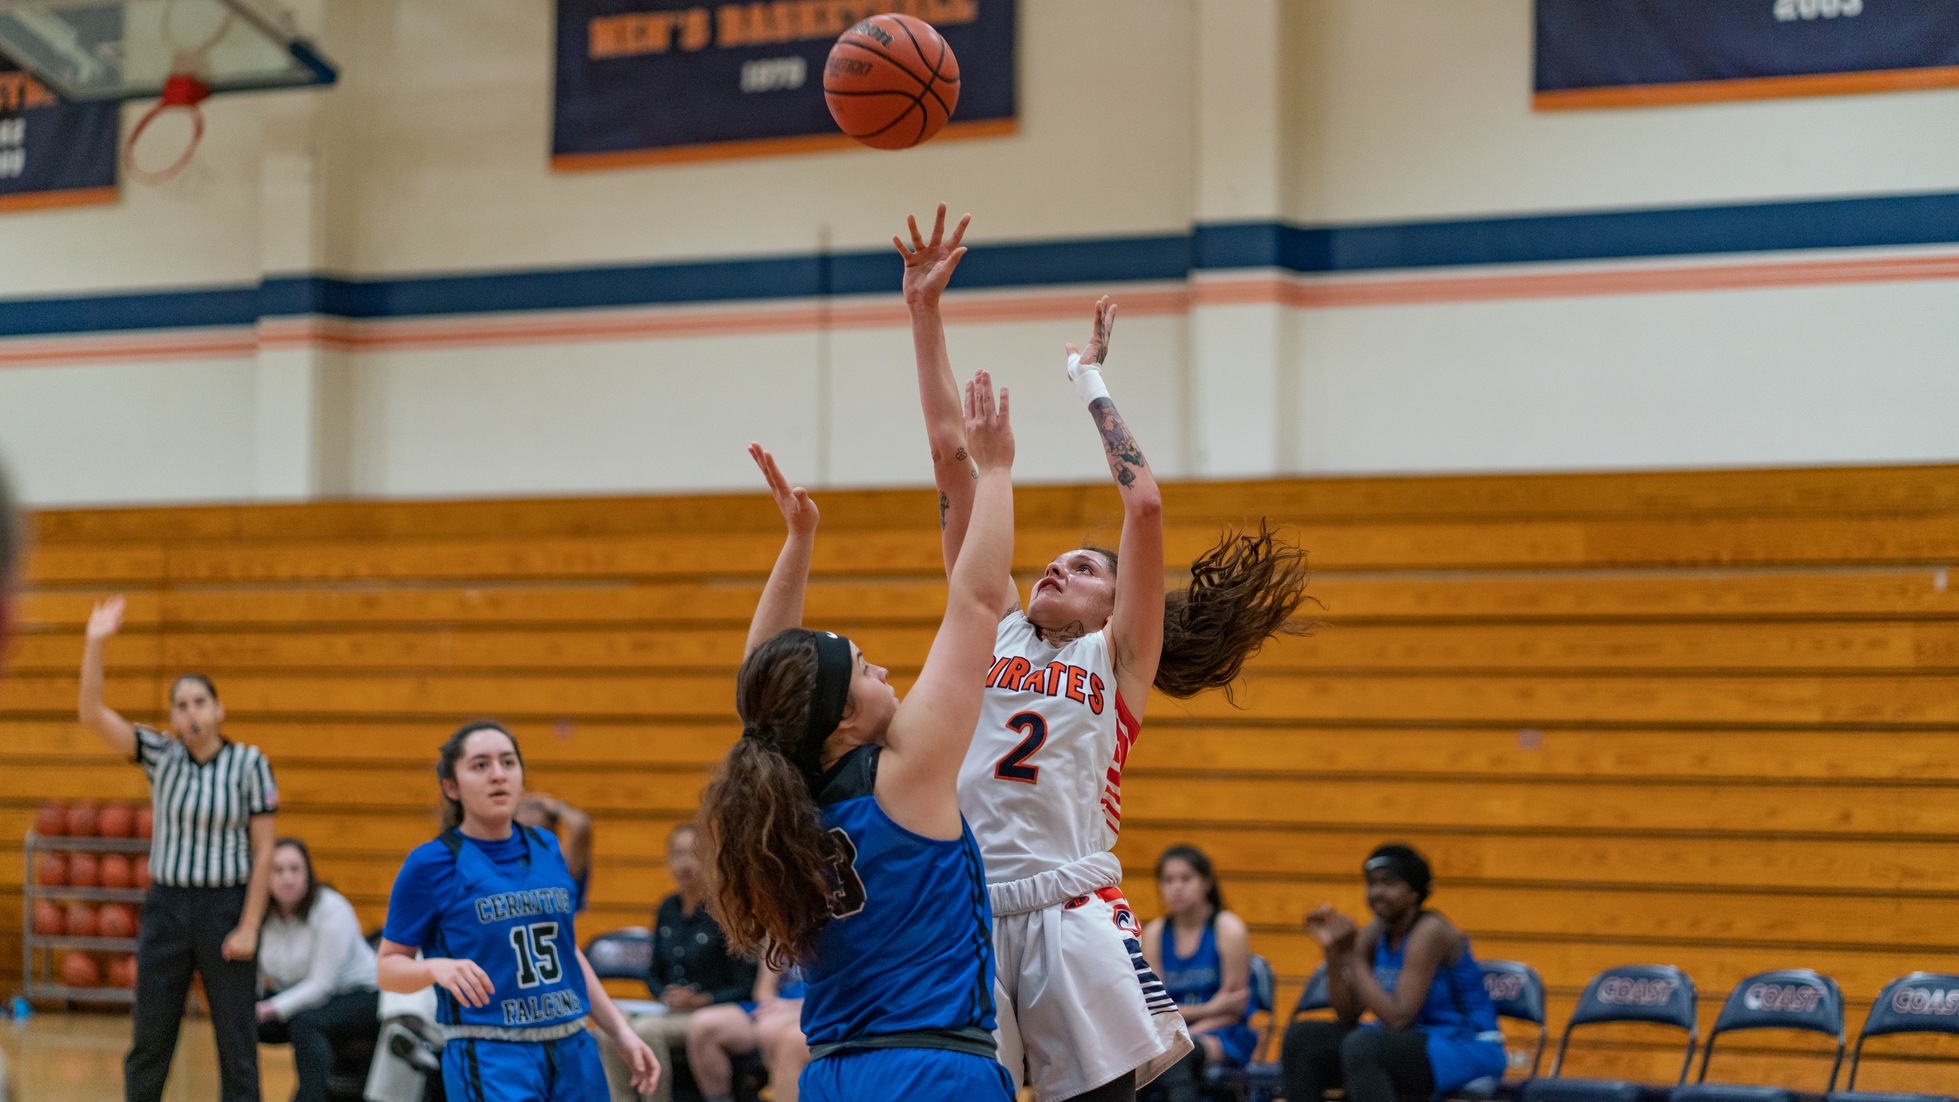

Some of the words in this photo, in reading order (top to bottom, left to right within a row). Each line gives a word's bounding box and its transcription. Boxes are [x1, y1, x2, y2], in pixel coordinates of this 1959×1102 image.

[588, 8, 711, 60] MEN'S
[985, 654, 1106, 716] IRATES
[994, 710, 1049, 785] 2
[509, 921, 563, 990] 15
[1596, 976, 1678, 1007] COAST
[1743, 982, 1826, 1013] COAST
[1891, 986, 1959, 1016] COAS
